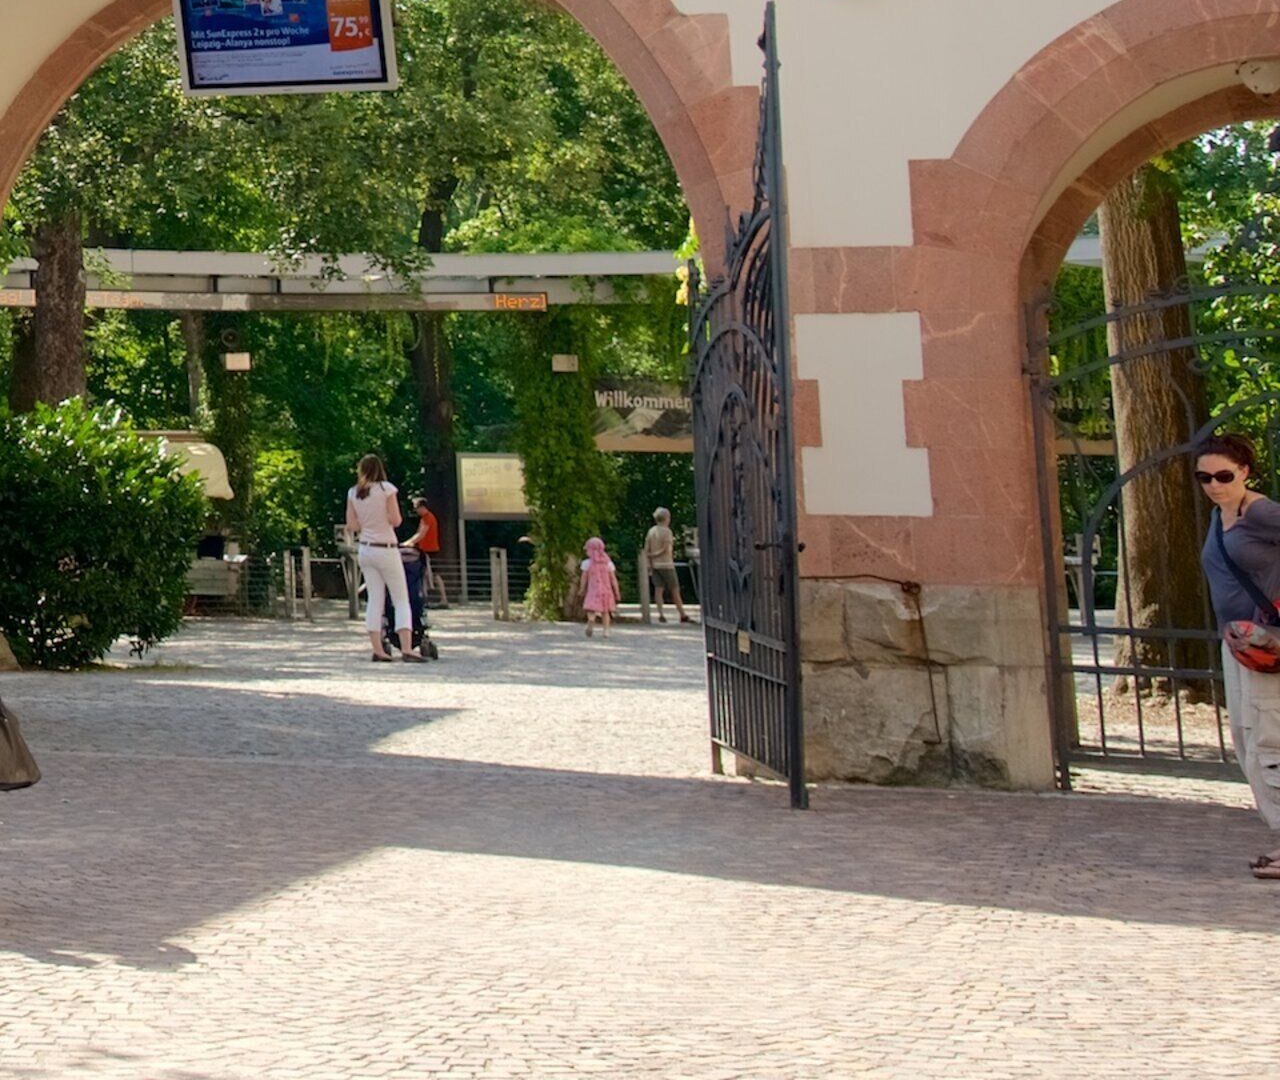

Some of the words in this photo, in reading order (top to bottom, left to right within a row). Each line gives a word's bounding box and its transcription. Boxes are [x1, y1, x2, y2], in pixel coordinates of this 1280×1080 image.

[191, 30, 205, 39] Mit
[206, 29, 252, 41] SunExpress
[266, 28, 280, 39] pro
[281, 26, 310, 36] Woche
[254, 38, 290, 47] nonstop!
